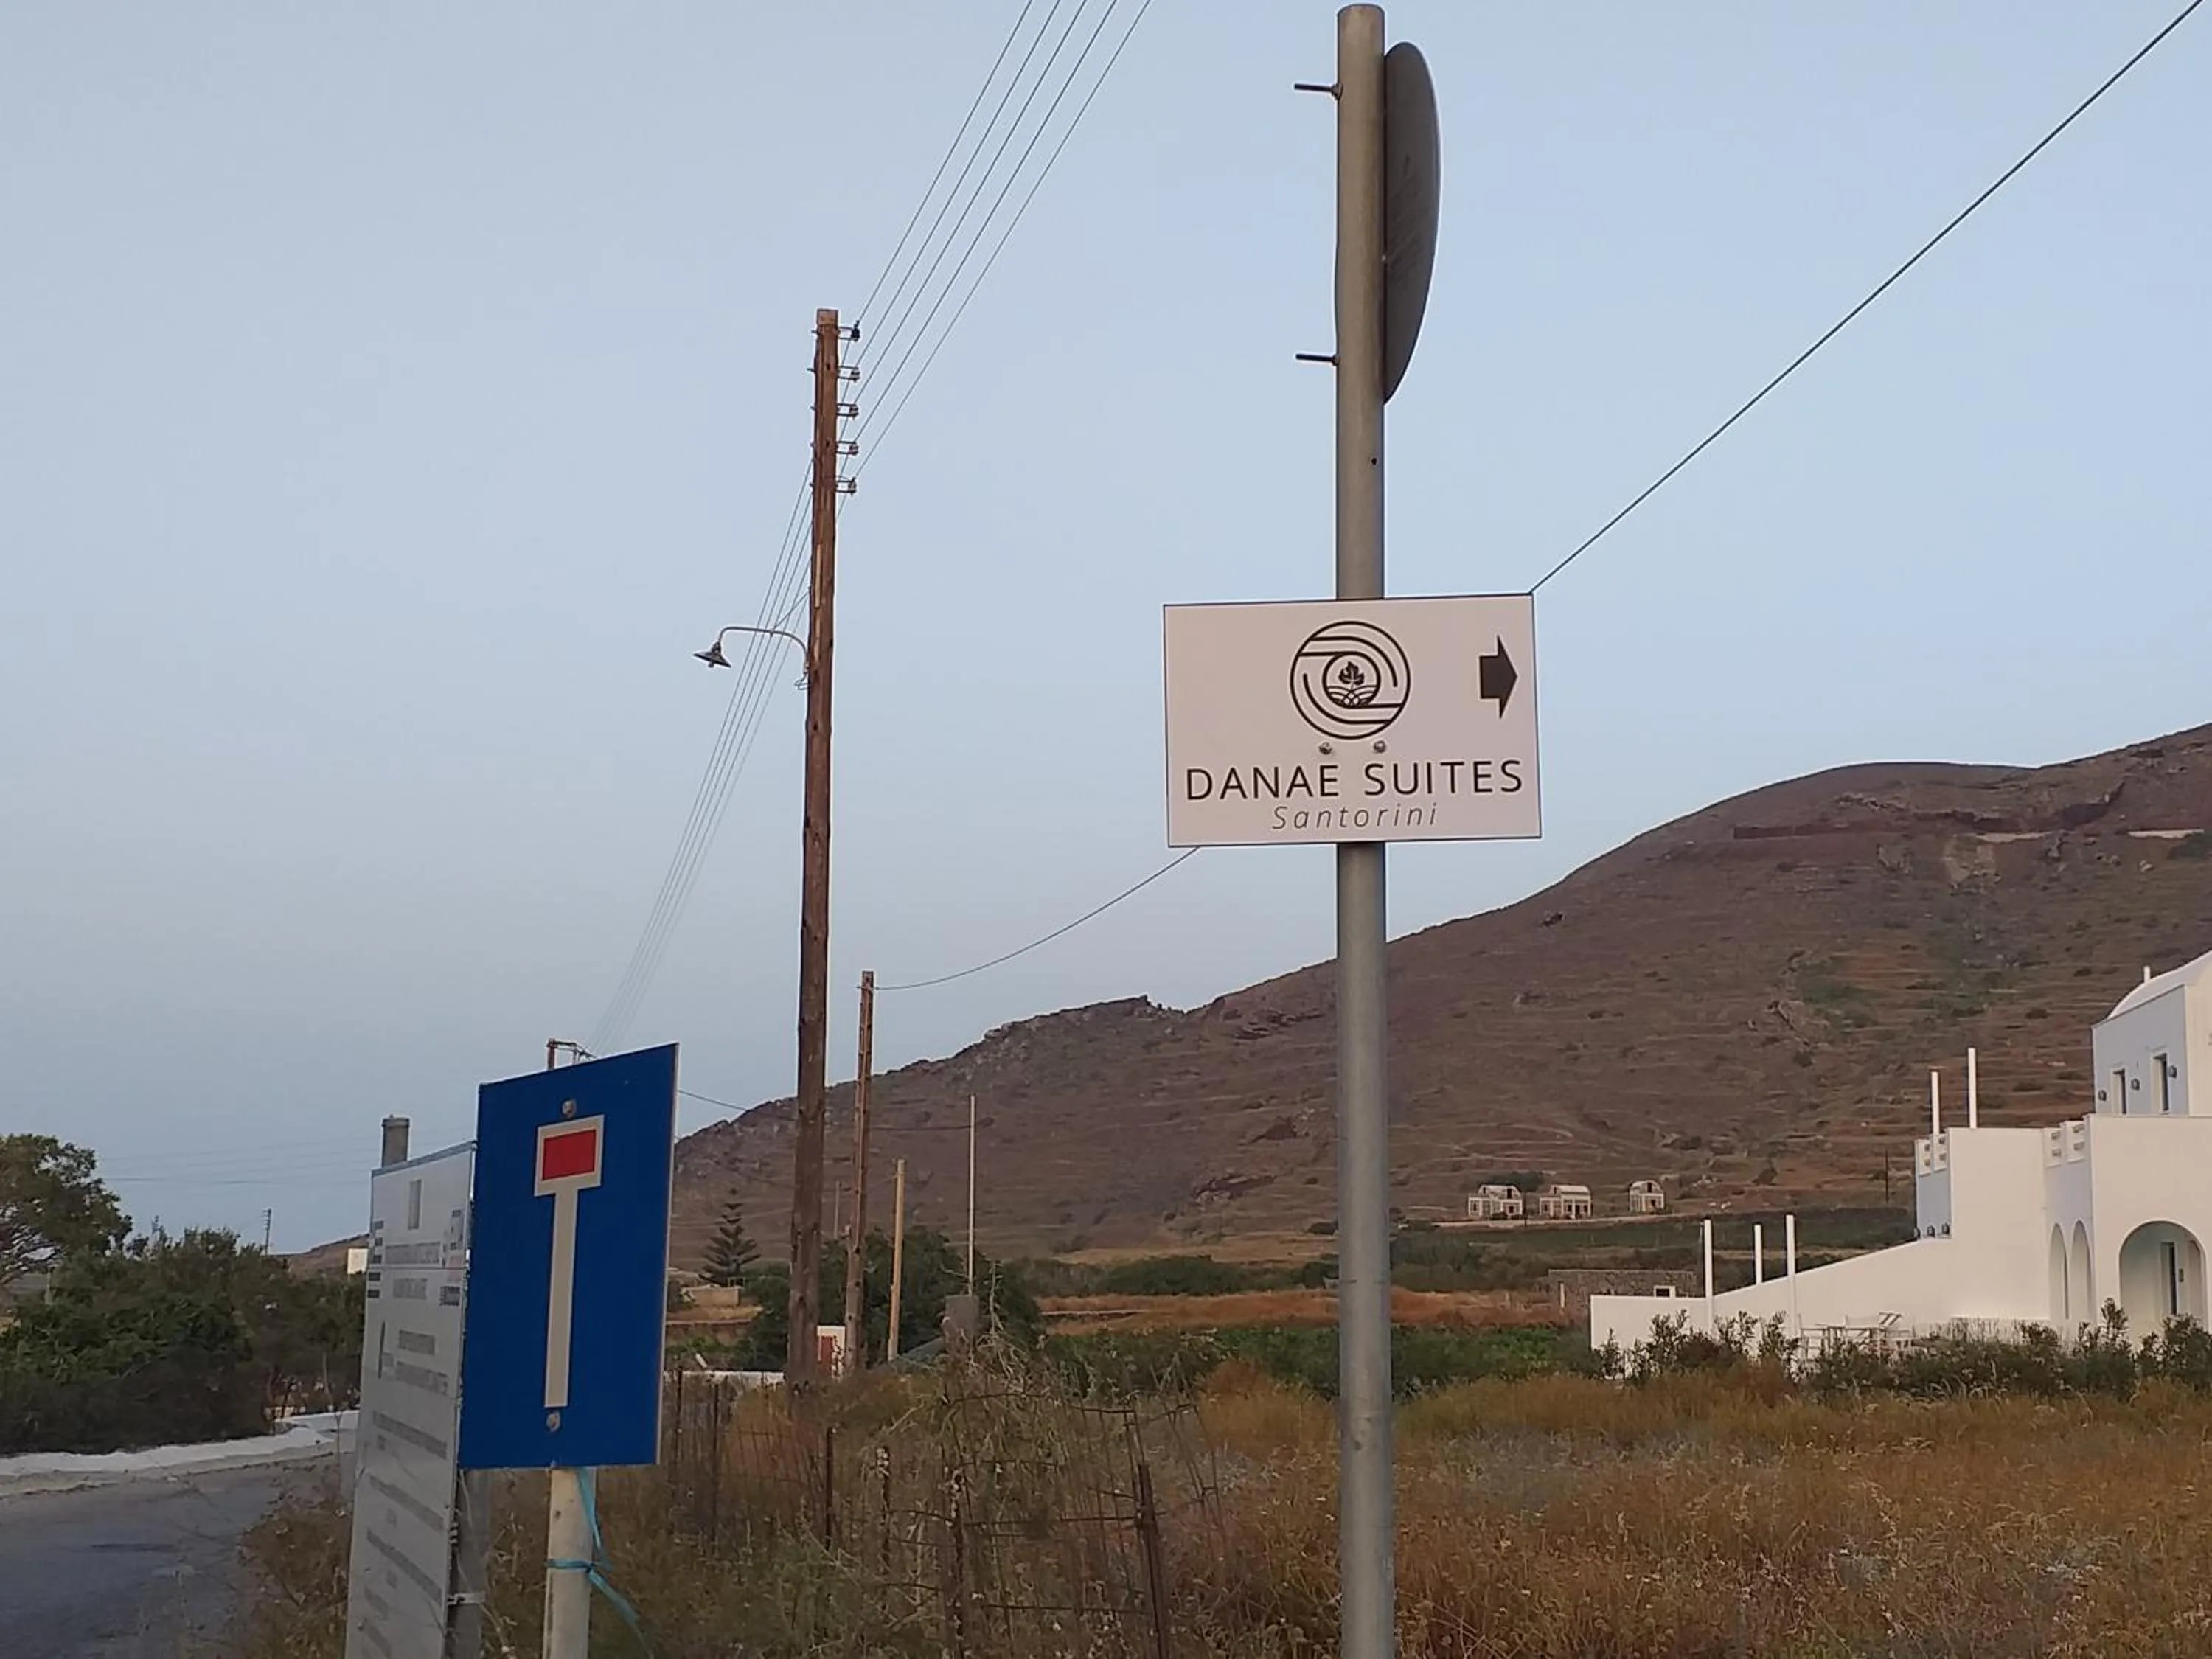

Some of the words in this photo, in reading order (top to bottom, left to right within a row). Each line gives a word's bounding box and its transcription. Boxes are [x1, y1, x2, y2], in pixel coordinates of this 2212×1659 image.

[1186, 765, 1340, 801] DANAE
[1363, 759, 1523, 796] SUITES
[1271, 803, 1438, 830] Santorini
